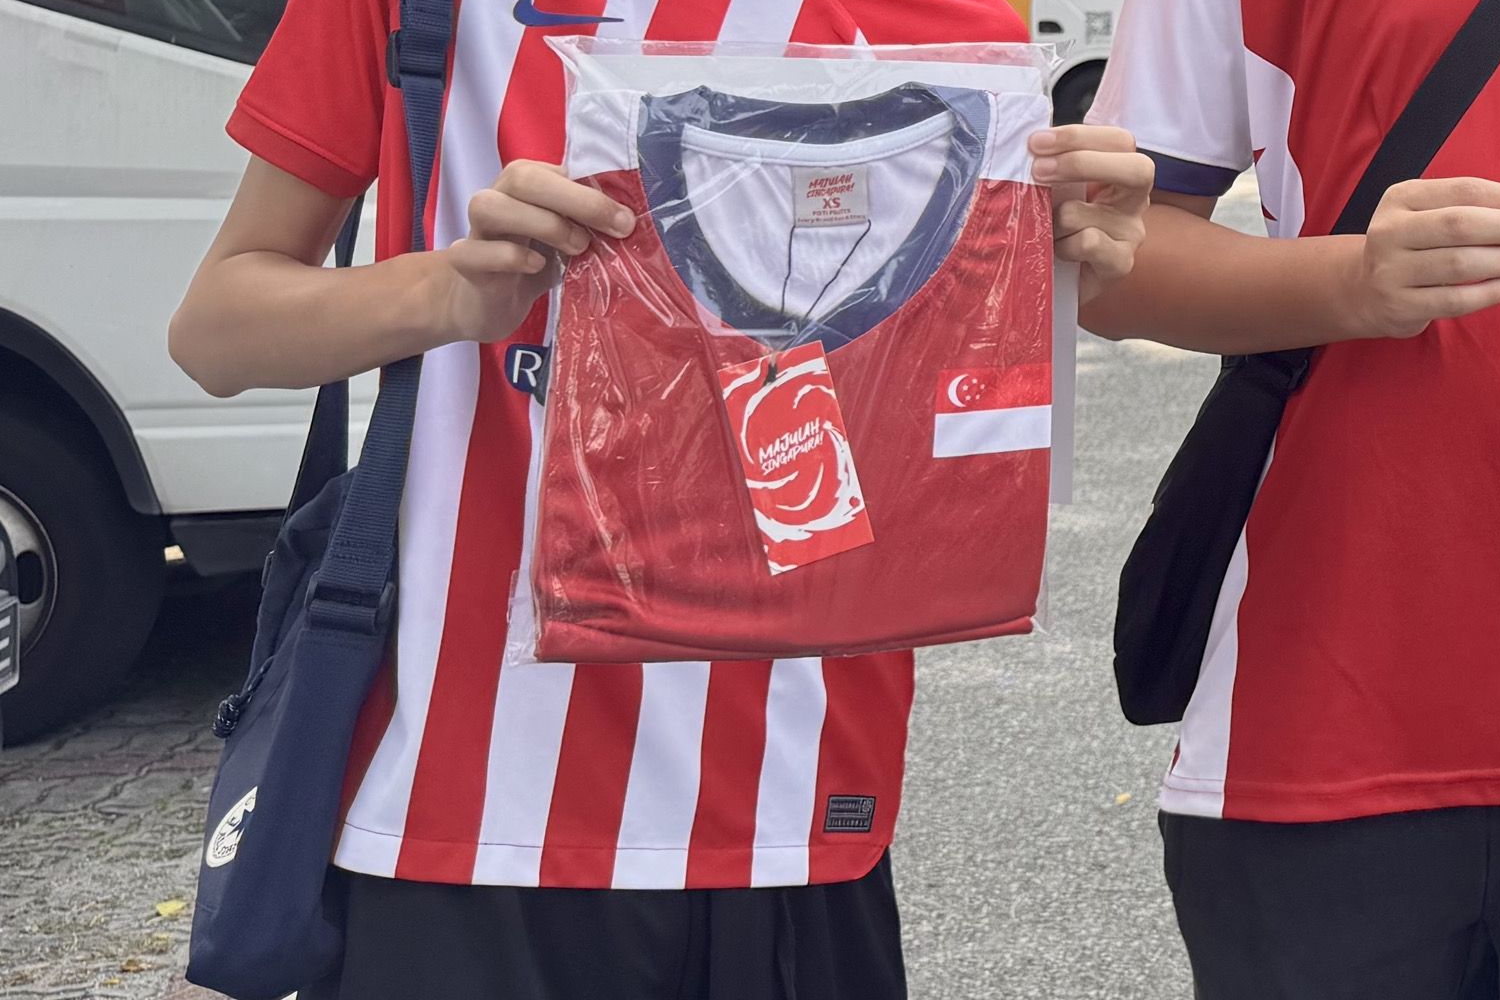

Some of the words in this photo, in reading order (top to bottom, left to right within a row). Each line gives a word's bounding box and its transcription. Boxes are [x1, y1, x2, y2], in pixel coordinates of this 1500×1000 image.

[823, 197, 841, 210] XS
[759, 417, 820, 464] MAJULAH
[762, 431, 824, 476] SINGAPURA!
